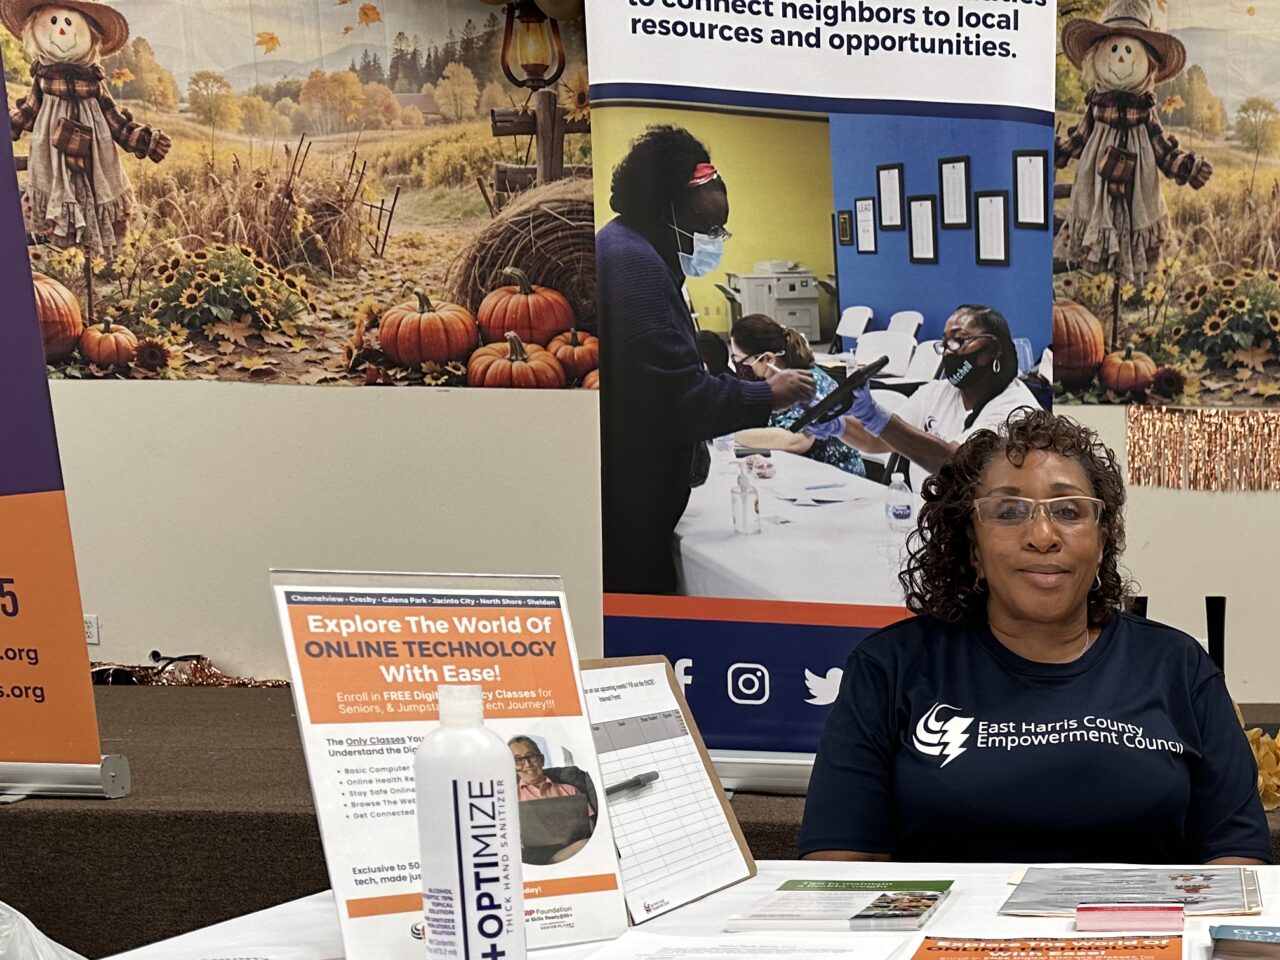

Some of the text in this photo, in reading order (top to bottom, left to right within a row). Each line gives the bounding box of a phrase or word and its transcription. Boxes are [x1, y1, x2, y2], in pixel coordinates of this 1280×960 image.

[662, 0, 774, 17] connect
[781, 0, 916, 26] neighbors
[923, 6, 950, 27] to
[957, 6, 1019, 31] local
[631, 17, 1017, 58] resources and opportunities.
[0, 578, 19, 617] 5
[291, 594, 345, 603] Channelview
[349, 596, 376, 604] Crosby
[460, 598, 475, 606] City
[307, 614, 551, 637] Explore The World Of
[304, 641, 556, 658] ONLINE TECHNOLOGY
[379, 663, 502, 683] With Ease!
[336, 691, 368, 702] Enroll
[371, 692, 380, 701] in
[383, 691, 411, 701] FREE
[496, 689, 536, 699] Classes
[538, 688, 552, 697] for
[338, 704, 384, 714] Seniors,
[386, 703, 394, 713] &
[507, 700, 555, 711] Journey!!!
[978, 715, 1144, 737] East Harris County
[326, 738, 344, 746] The
[346, 736, 368, 747] Only
[370, 736, 406, 745] Classes
[976, 730, 1184, 755] Empowerment Council
[328, 747, 384, 757] Understand
[386, 746, 401, 754] the
[344, 765, 410, 775] Basic Computer
[347, 778, 373, 786] Online
[376, 776, 402, 784] Health
[349, 787, 416, 798] Stay Safe Online
[370, 809, 415, 818] Connected
[497, 779, 513, 935] THICK HAND SANITIZER
[352, 862, 420, 875] Exclusive to 50
[355, 876, 378, 886] tech,
[381, 874, 407, 884] made
[536, 906, 573, 915] Foundation
